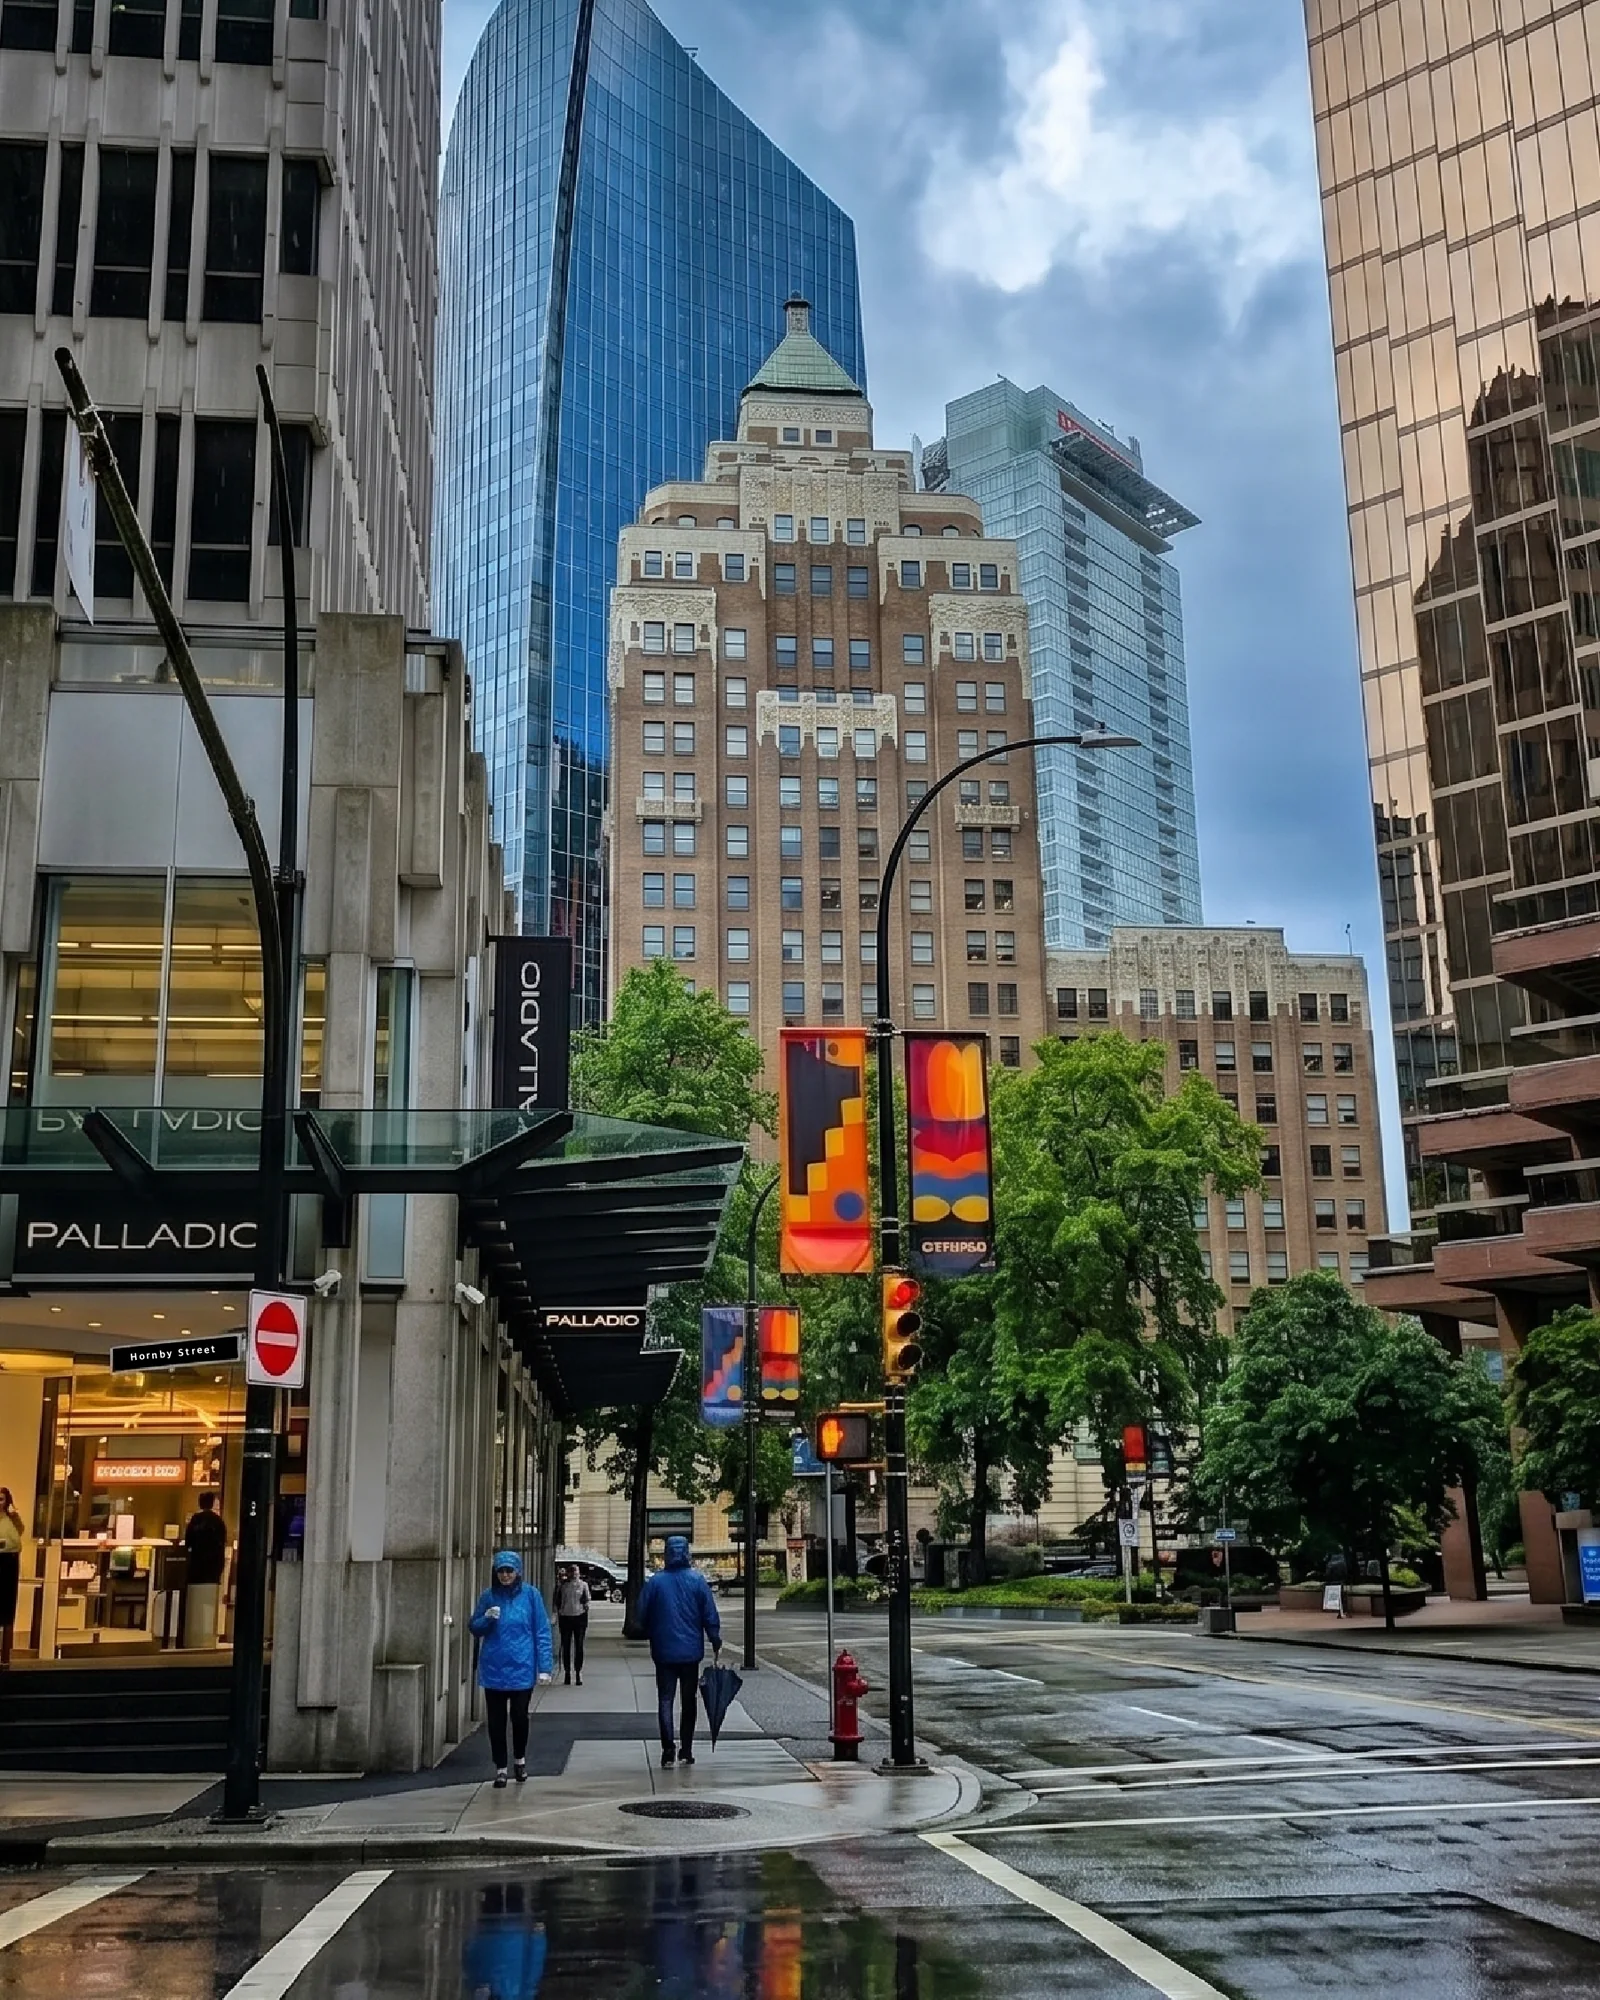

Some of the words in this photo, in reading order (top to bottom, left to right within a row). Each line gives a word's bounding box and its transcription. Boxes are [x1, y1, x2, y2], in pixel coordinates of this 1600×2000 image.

[546, 1315, 640, 1327] PALLADIO
[130, 1350, 172, 1361] Hornby
[178, 1345, 216, 1356] Street
